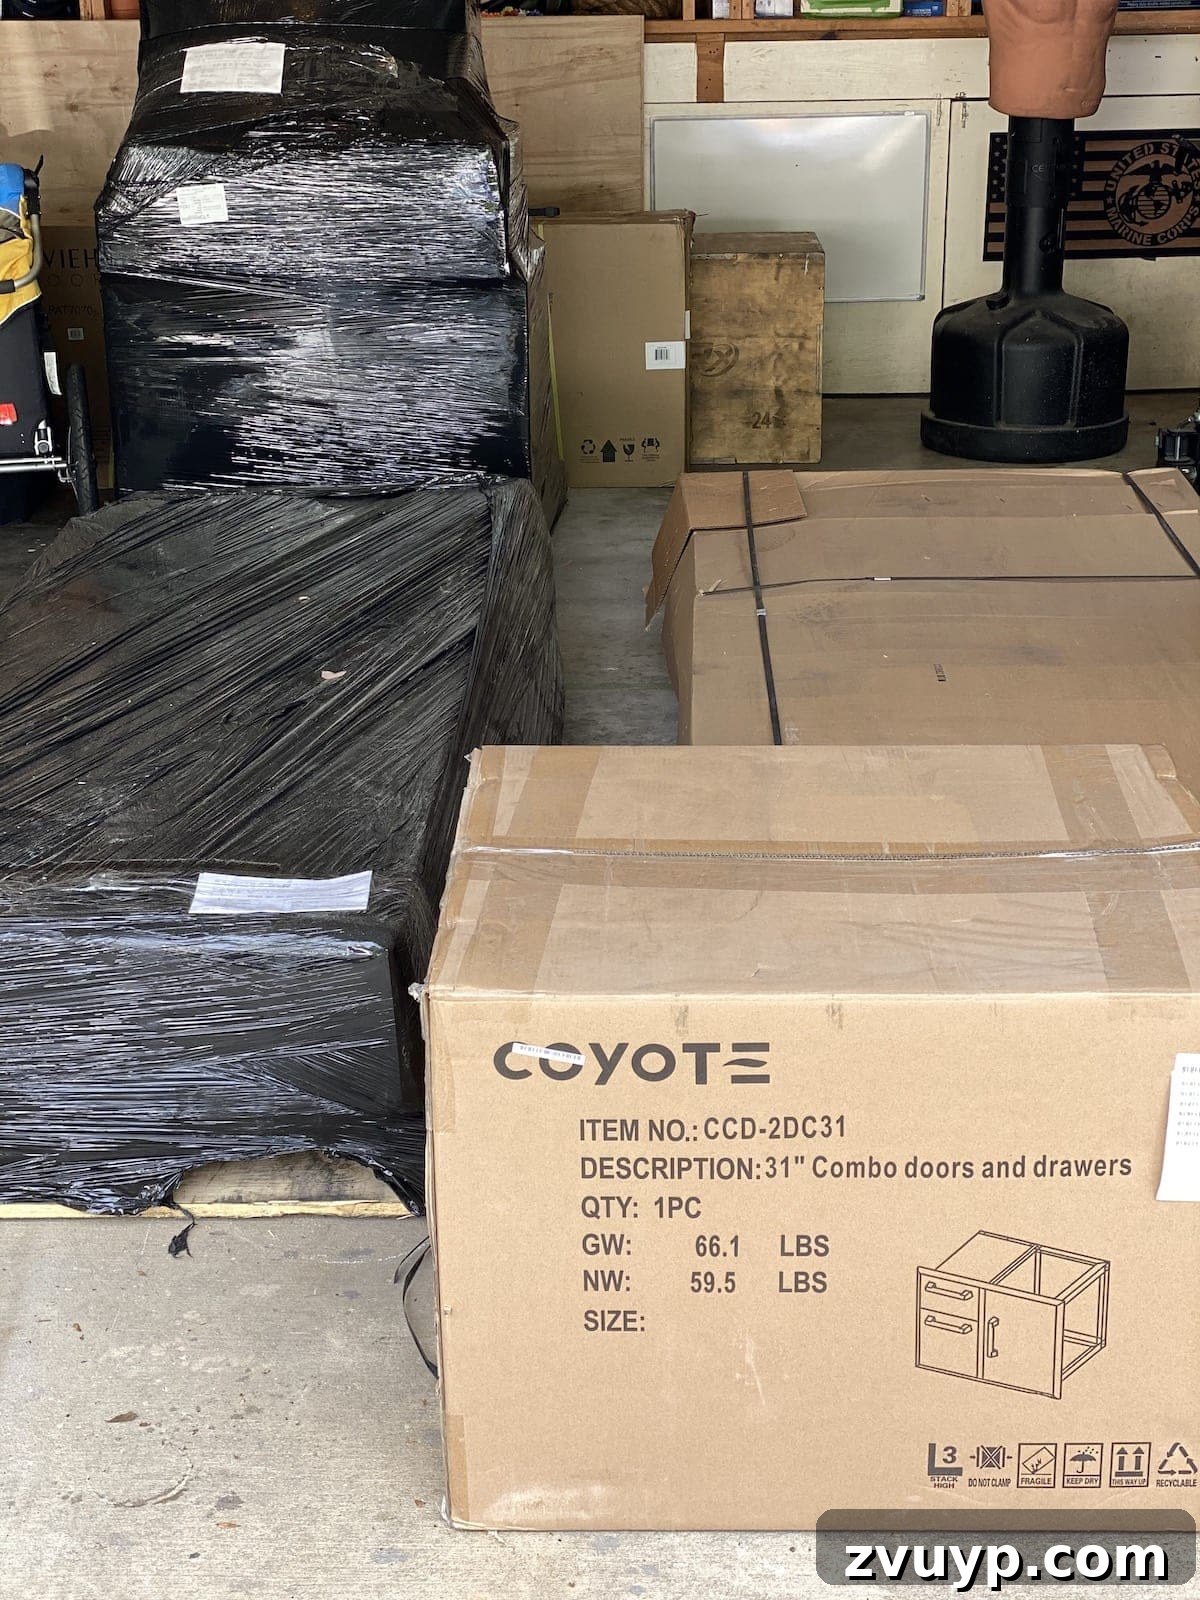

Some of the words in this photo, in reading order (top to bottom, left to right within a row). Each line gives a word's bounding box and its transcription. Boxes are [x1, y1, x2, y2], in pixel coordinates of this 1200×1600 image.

[1105, 143, 1155, 191] UNITED
[1106, 207, 1152, 245] MARINE
[1157, 206, 1200, 244] CORPS
[493, 1041, 771, 1086] COYOTE
[579, 1119, 639, 1142] ITEM
[703, 1115, 846, 1140] CCD-2DC31
[812, 1156, 897, 1179] Combo
[904, 1156, 974, 1179] doors
[982, 1155, 1026, 1178] and
[1033, 1154, 1132, 1178] drawers
[581, 1196, 639, 1219] QTY:
[653, 1196, 702, 1219] 1PC
[581, 1233, 632, 1256] GW:
[695, 1235, 740, 1257] 66.1
[780, 1234, 830, 1257] LBS
[583, 1270, 631, 1292] NW:
[690, 1271, 736, 1294] 59.5
[778, 1271, 828, 1293] LBS
[583, 1310, 645, 1332] SIZE:
[968, 1478, 977, 1488] DO
[978, 1478, 991, 1488] NOT
[991, 1478, 1012, 1488] CLAMP
[1020, 1477, 1052, 1485] FRAGILE
[1066, 1477, 1083, 1485] KEEP
[1084, 1477, 1099, 1485] DRY
[1156, 1479, 1197, 1488] RECYCLABLE
